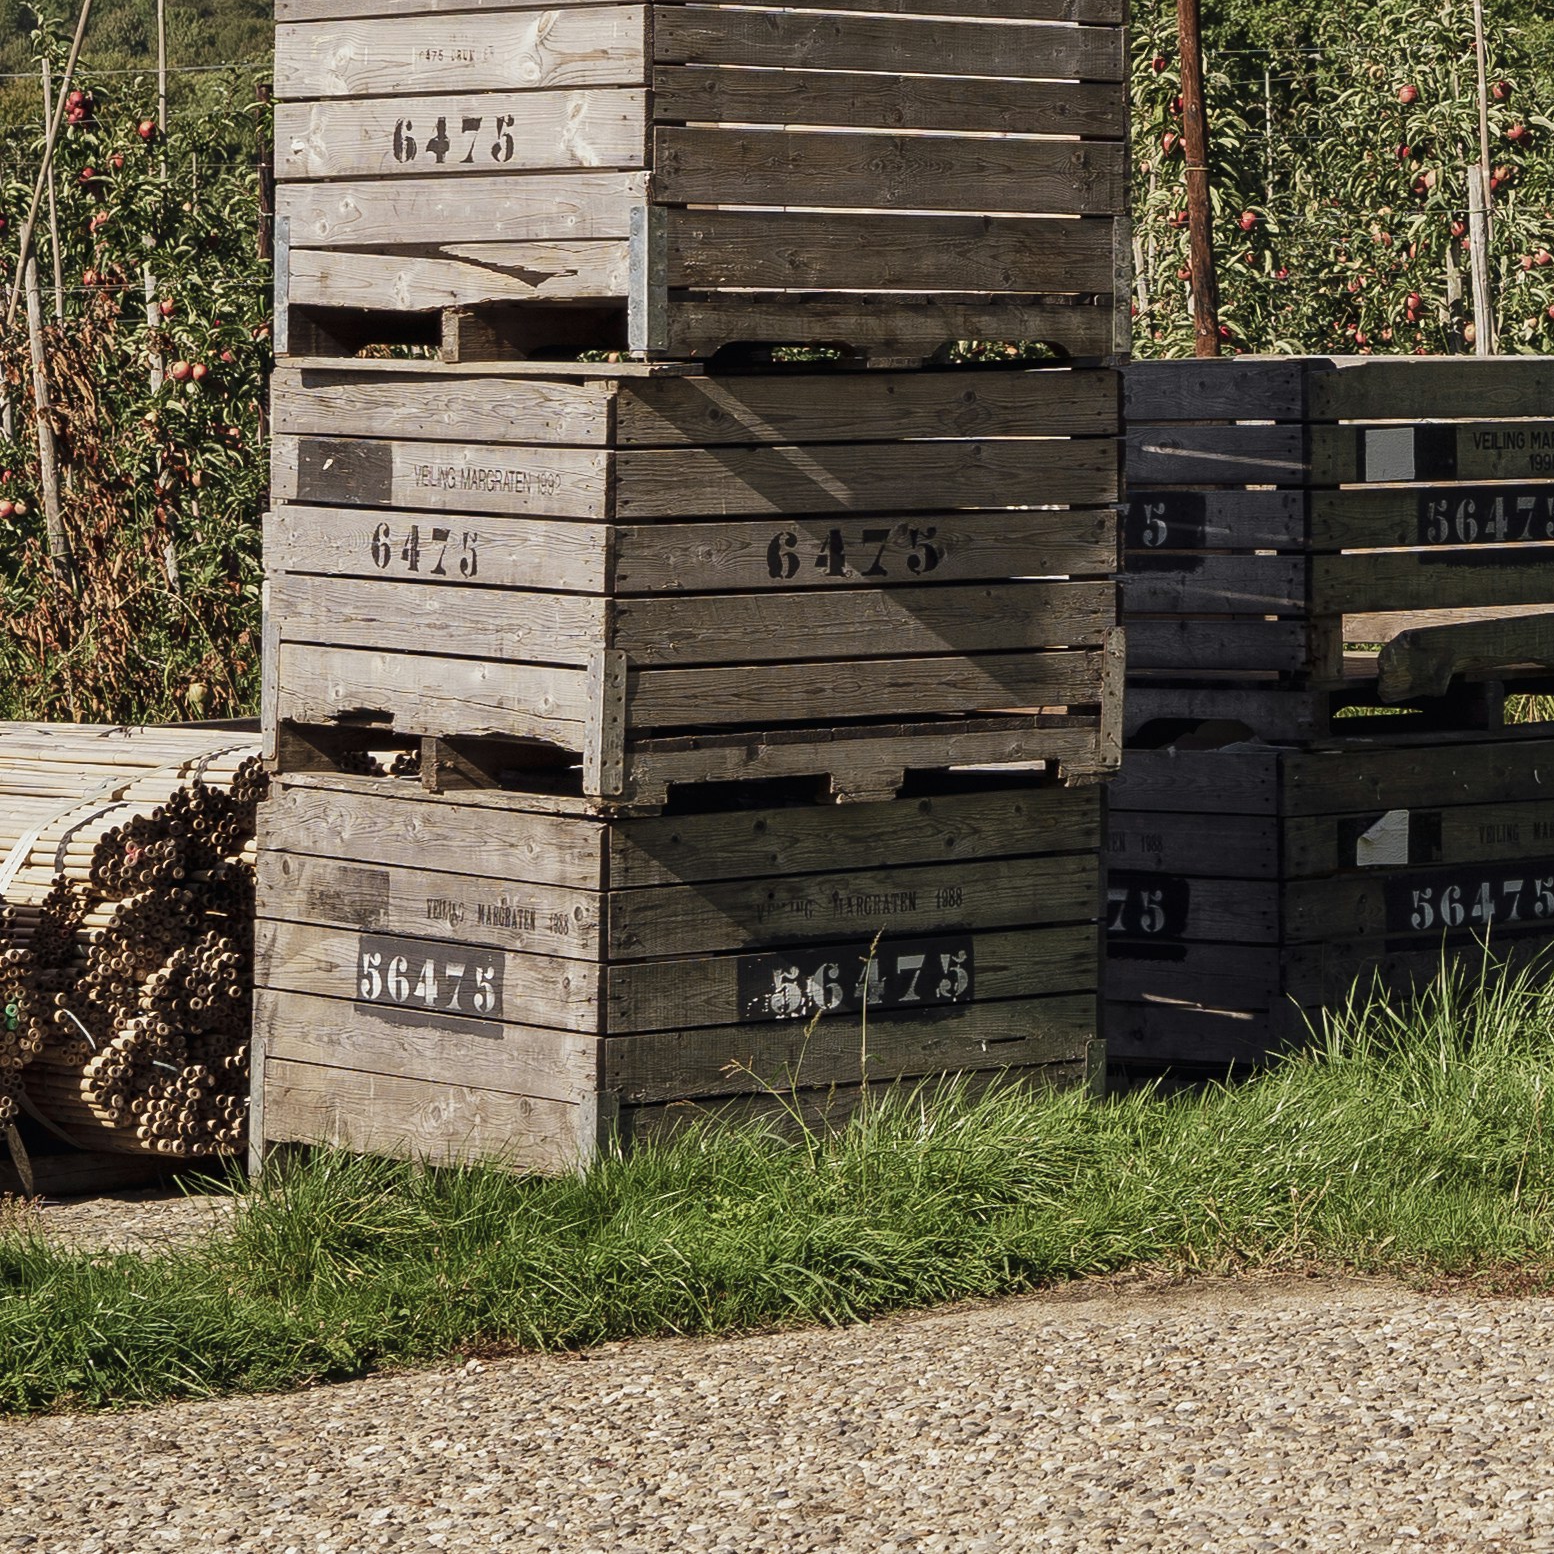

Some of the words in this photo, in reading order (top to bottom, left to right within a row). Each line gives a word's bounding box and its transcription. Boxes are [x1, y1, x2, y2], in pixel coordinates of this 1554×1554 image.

[393, 114, 515, 164] 6475
[1473, 430, 1526, 451] VEILING
[460, 467, 532, 494] MARGRATEN
[371, 521, 479, 580] 6475
[766, 526, 940, 580] 6475
[1480, 822, 1519, 845] VEILING
[477, 903, 537, 931] MARGRATEN
[360, 952, 497, 1013] 56475
[770, 950, 970, 1015] 56475
